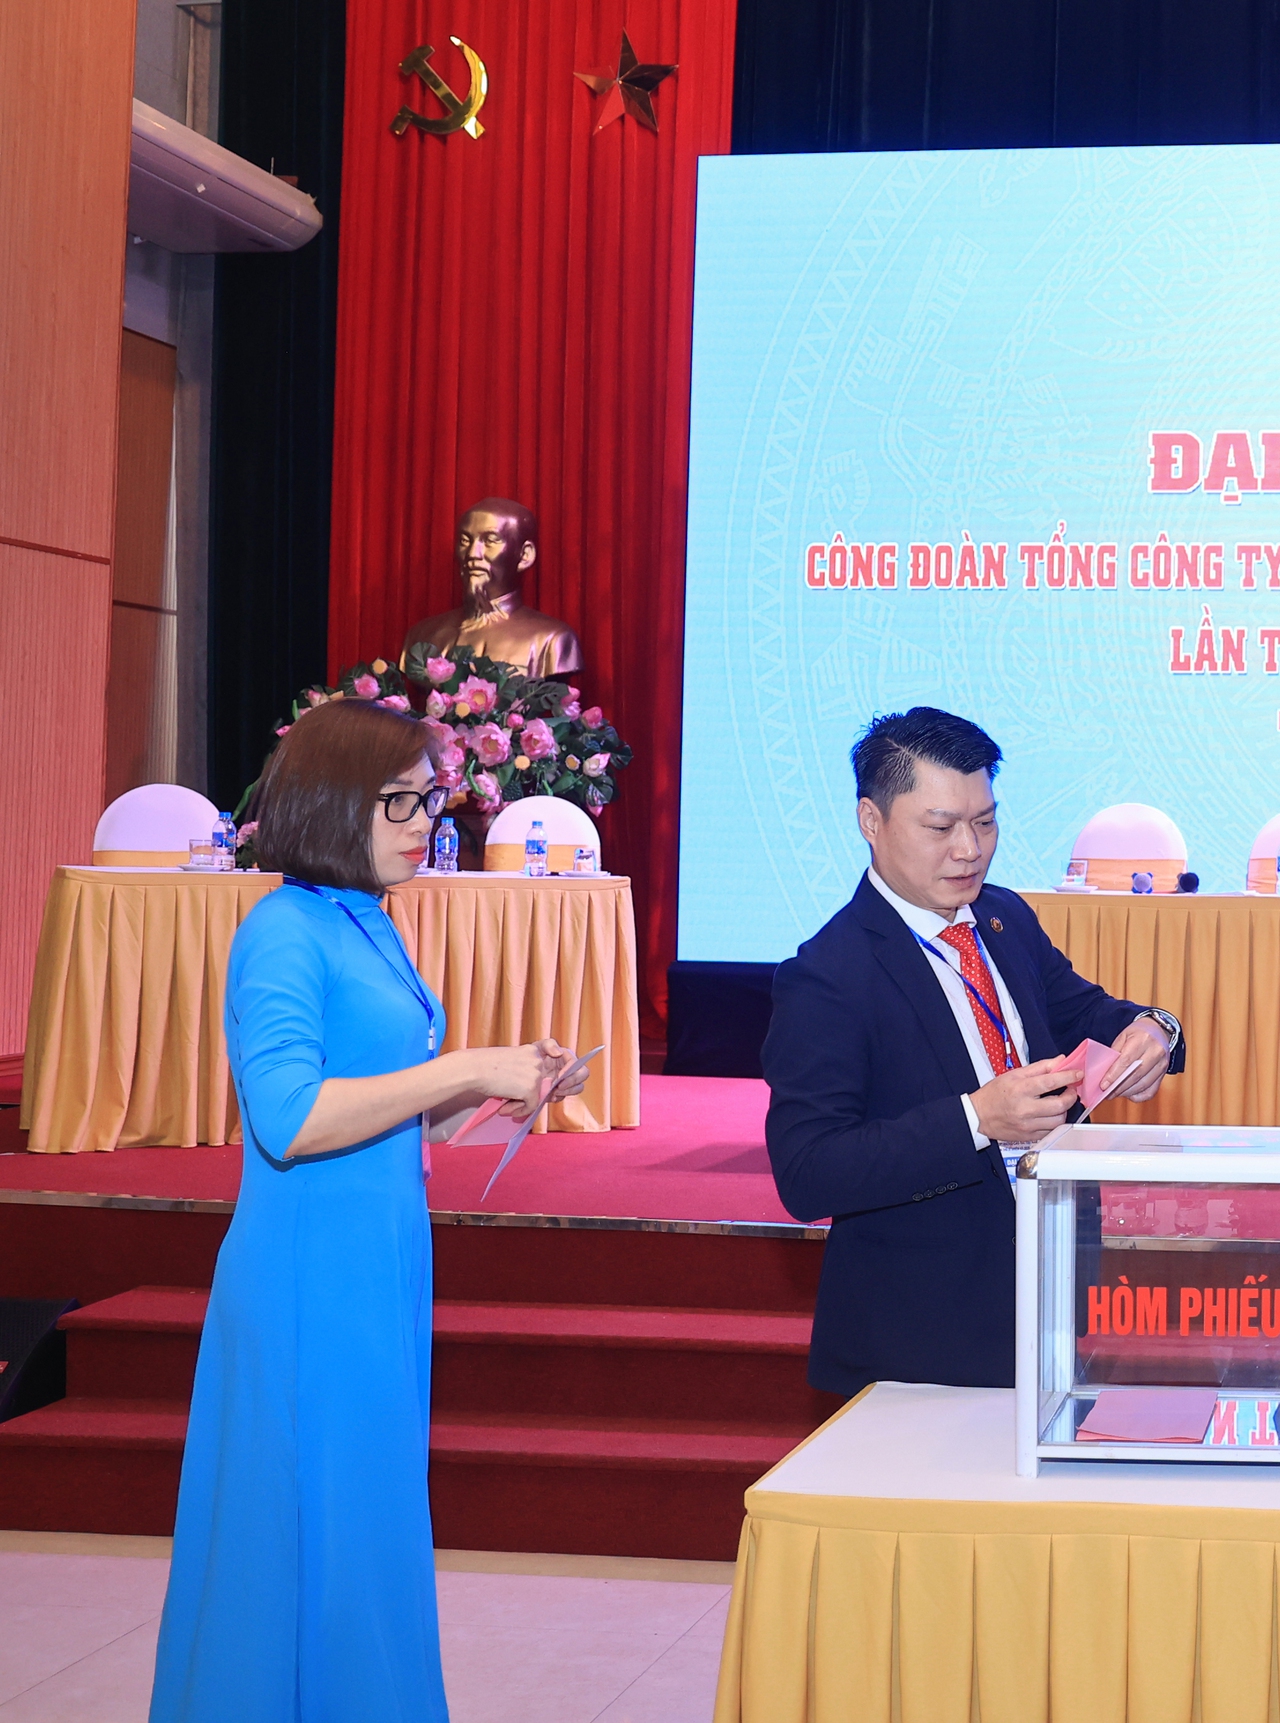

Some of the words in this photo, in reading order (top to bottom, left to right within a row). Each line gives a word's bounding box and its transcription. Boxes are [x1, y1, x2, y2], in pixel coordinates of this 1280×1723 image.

[806, 533, 897, 588] CÔNG
[909, 532, 1007, 588] ĐOÀN
[1019, 521, 1117, 588] TỔNG
[1129, 533, 1223, 588] CÔNG
[1170, 606, 1246, 673] LẦN
[1088, 1275, 1167, 1336] HÒM
